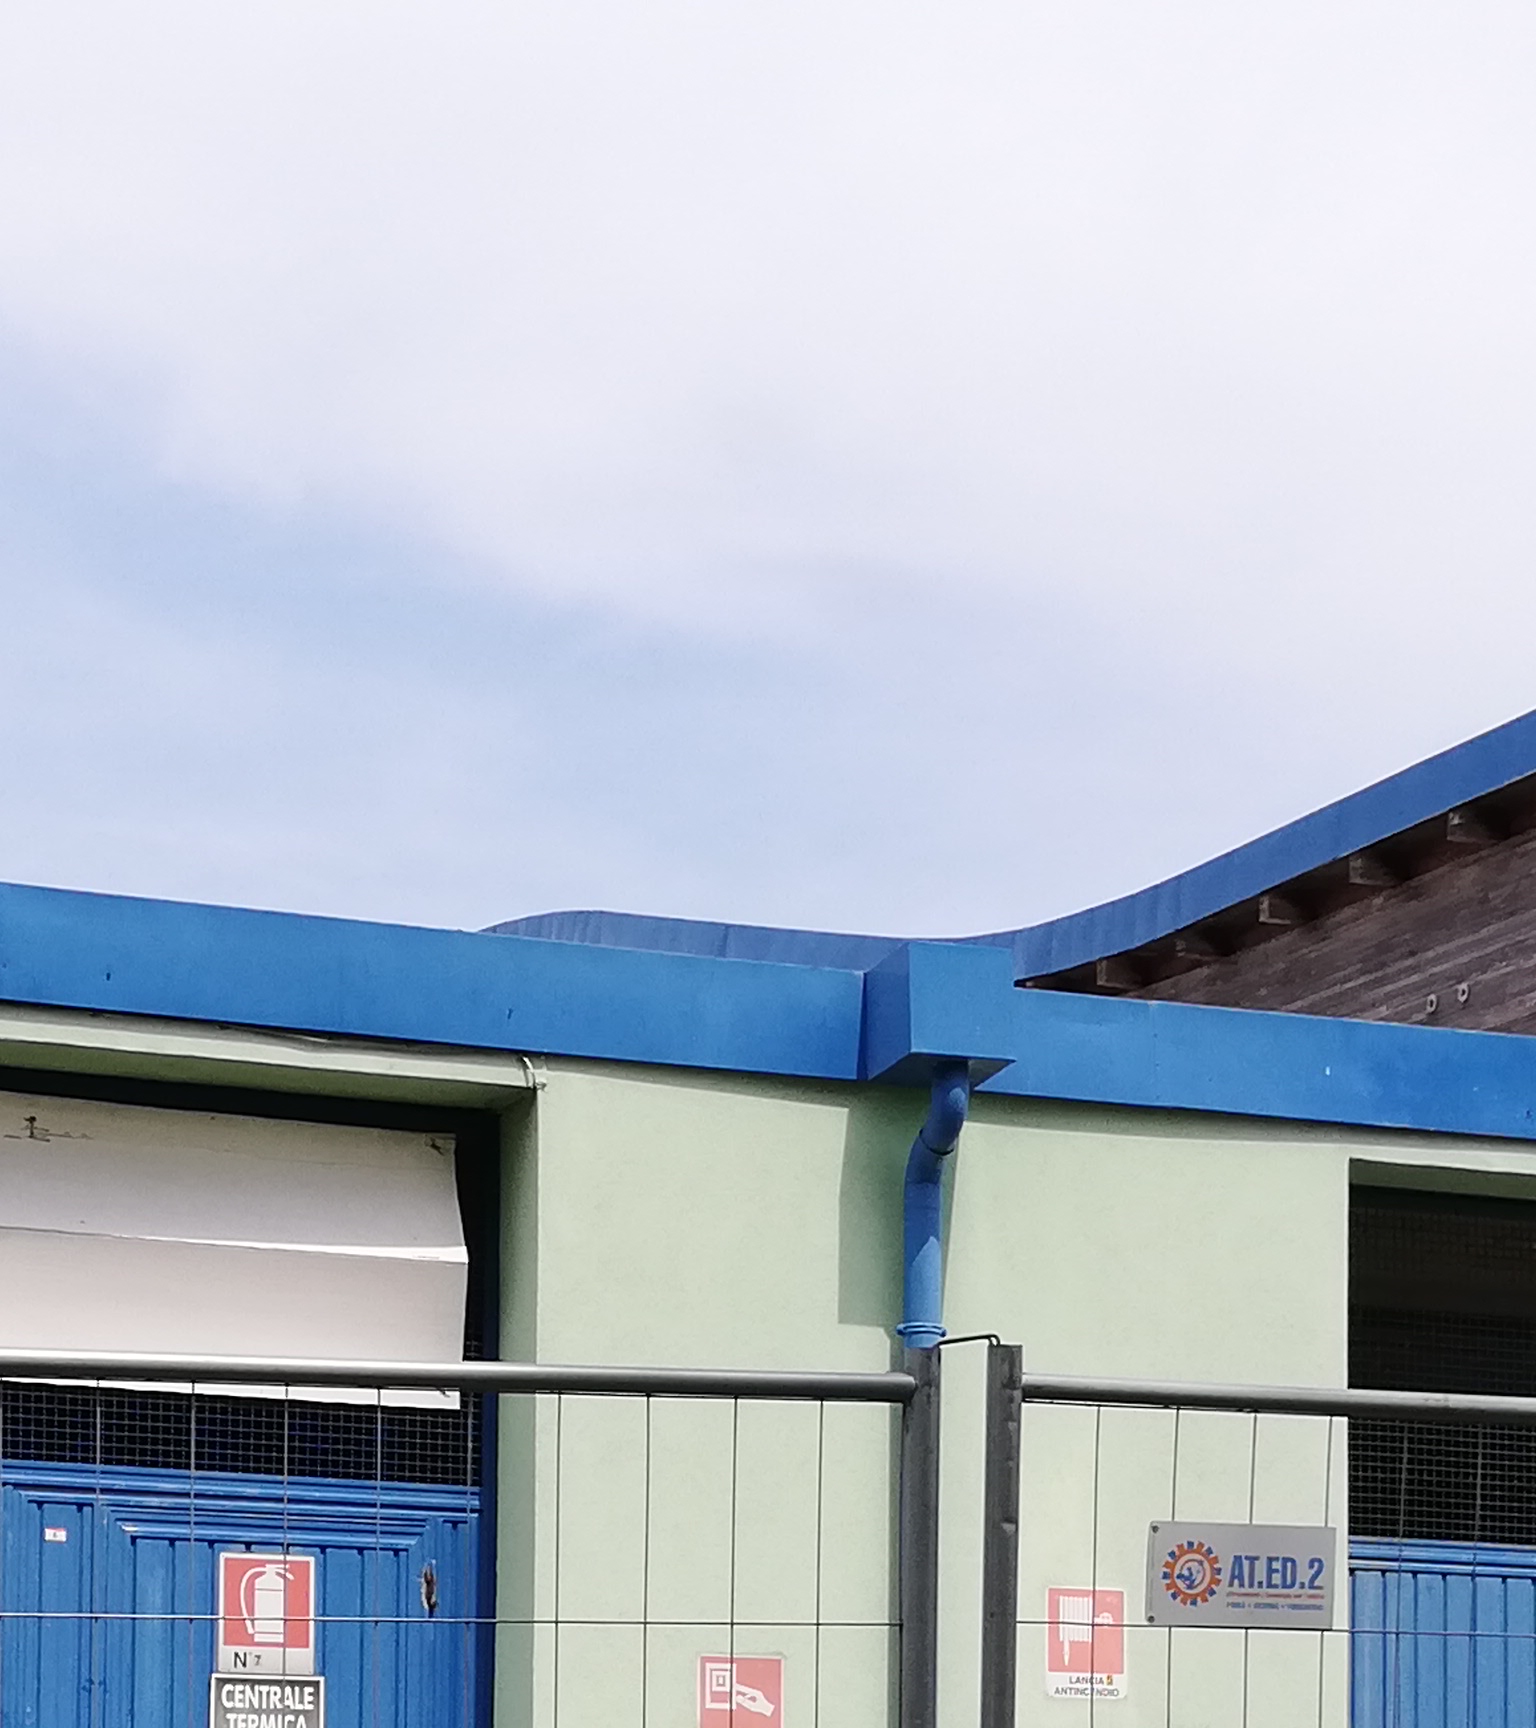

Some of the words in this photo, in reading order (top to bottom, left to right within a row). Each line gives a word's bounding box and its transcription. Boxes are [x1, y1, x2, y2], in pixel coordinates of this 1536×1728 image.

[1227, 1555, 1325, 1590] AT.ED.2
[221, 1683, 315, 1711] CENTRALE
[1054, 1686, 1120, 1697] ANTINCNDIO
